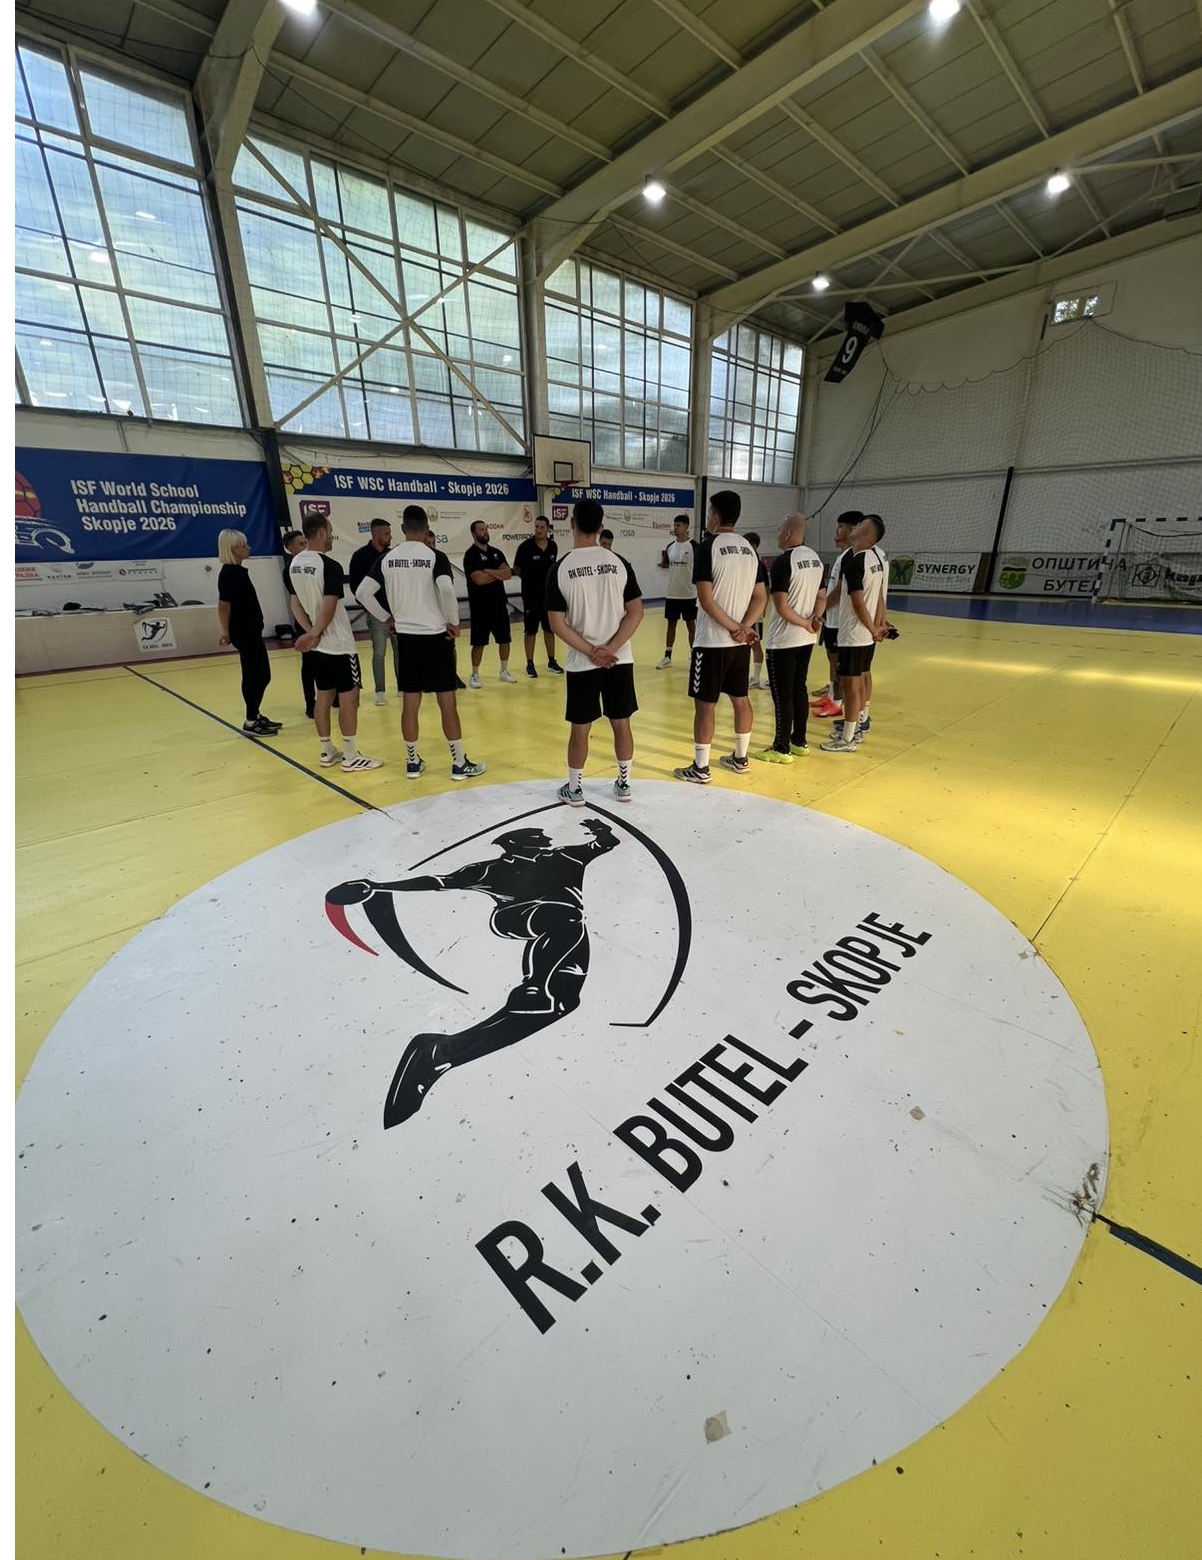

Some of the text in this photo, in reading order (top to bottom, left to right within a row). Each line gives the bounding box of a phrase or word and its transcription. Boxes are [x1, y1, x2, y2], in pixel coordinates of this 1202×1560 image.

[71, 479, 200, 498] ISF World School
[334, 475, 353, 490] ISF
[357, 476, 385, 491] WSC
[388, 478, 437, 494] Handball
[448, 481, 483, 497] Skopje
[485, 483, 510, 496] 2026
[572, 489, 584, 499] ISF
[586, 489, 602, 500] WSC
[603, 490, 633, 502] Handball
[639, 492, 659, 504] Skopje
[661, 493, 676, 503] 2026
[76, 498, 248, 518] Handball Championship
[81, 515, 176, 534] Skopje 2026
[916, 563, 977, 575] SYNERGY
[474, 1160, 662, 1336] R.K.
[612, 1033, 810, 1194] BUTEL
[785, 911, 934, 1022] SKOPJE
